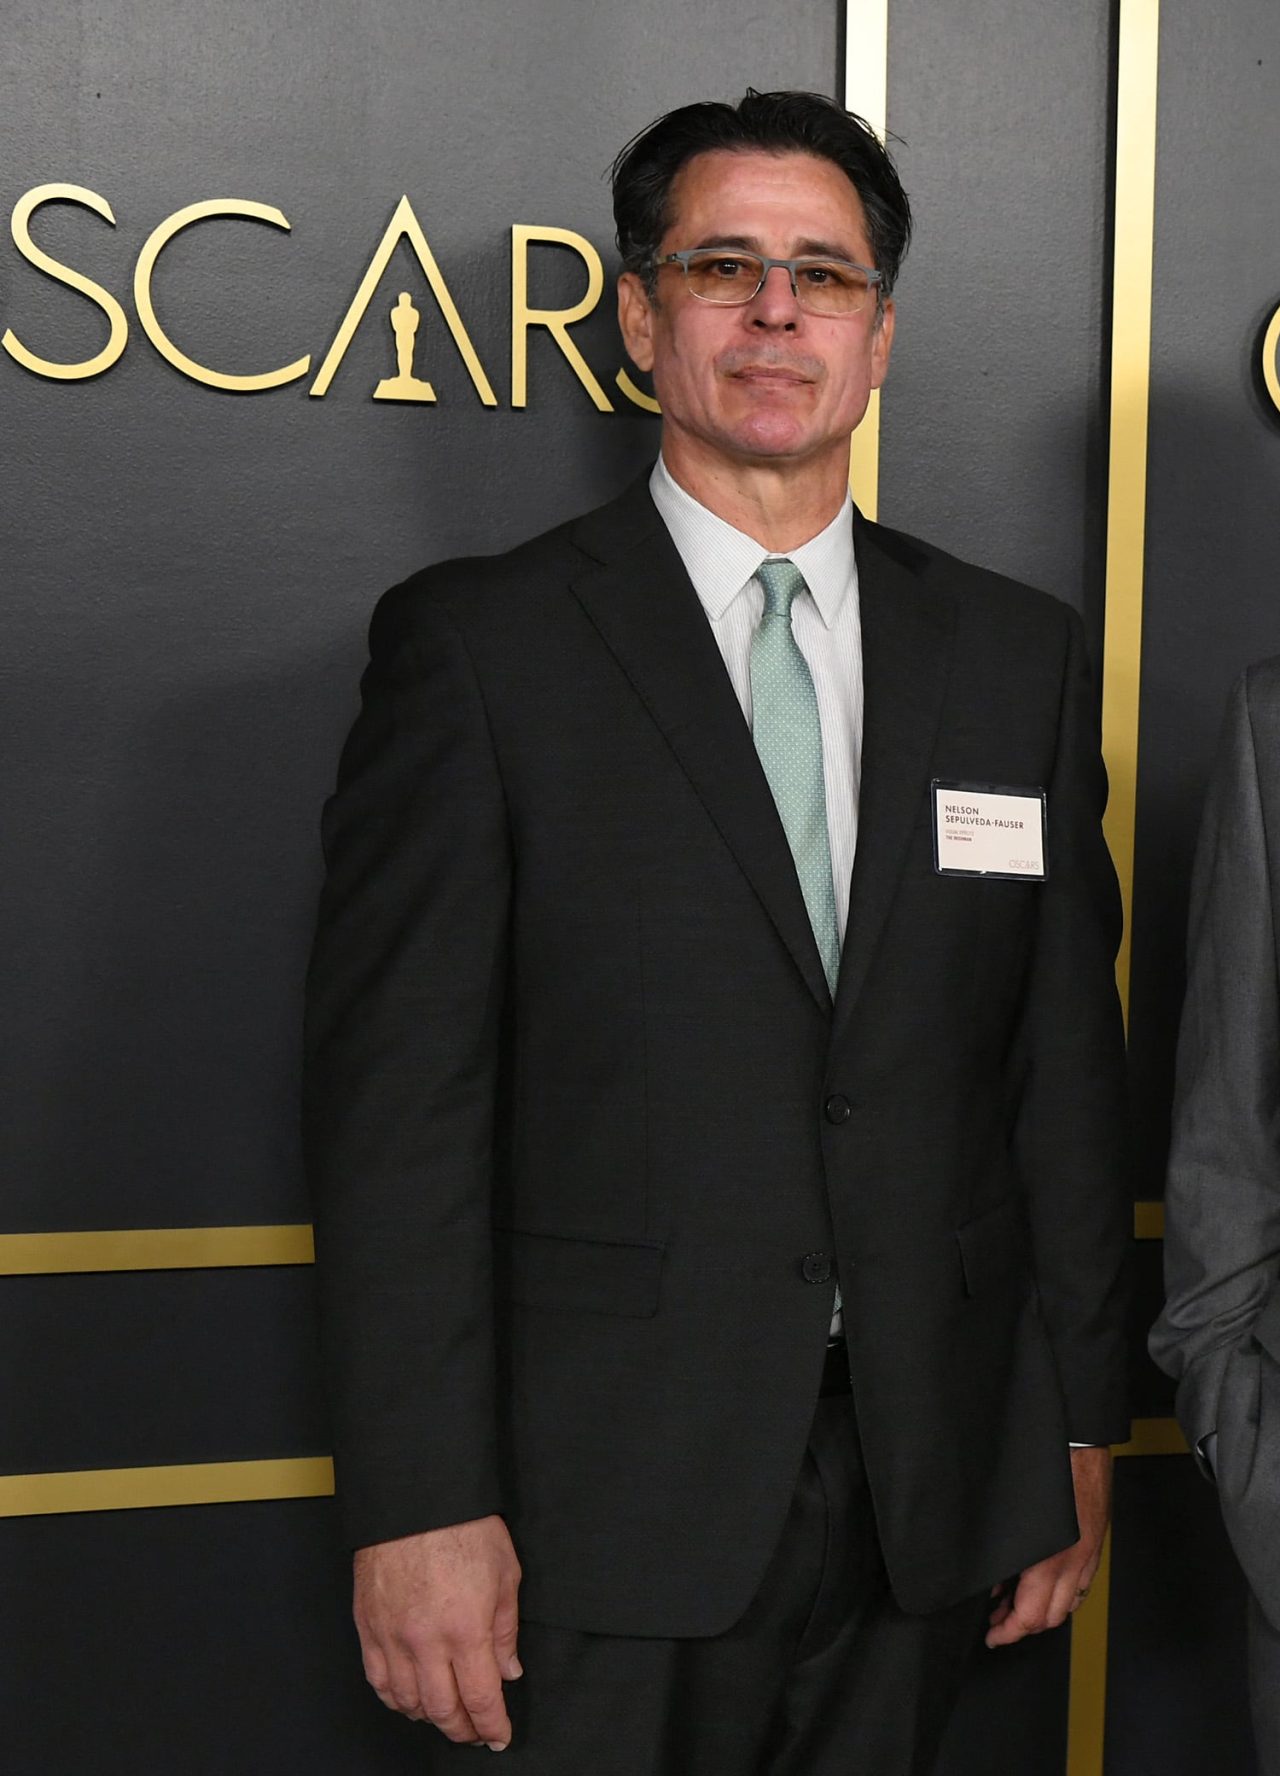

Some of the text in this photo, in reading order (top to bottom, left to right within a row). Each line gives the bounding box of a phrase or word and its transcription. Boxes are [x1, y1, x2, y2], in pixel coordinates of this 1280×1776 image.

[1, 182, 664, 415] SCAR
[945, 805, 979, 815] NELSON
[945, 815, 1024, 829] SEPULVEDA-FAUSER
[1009, 859, 1040, 870] OSCARS
